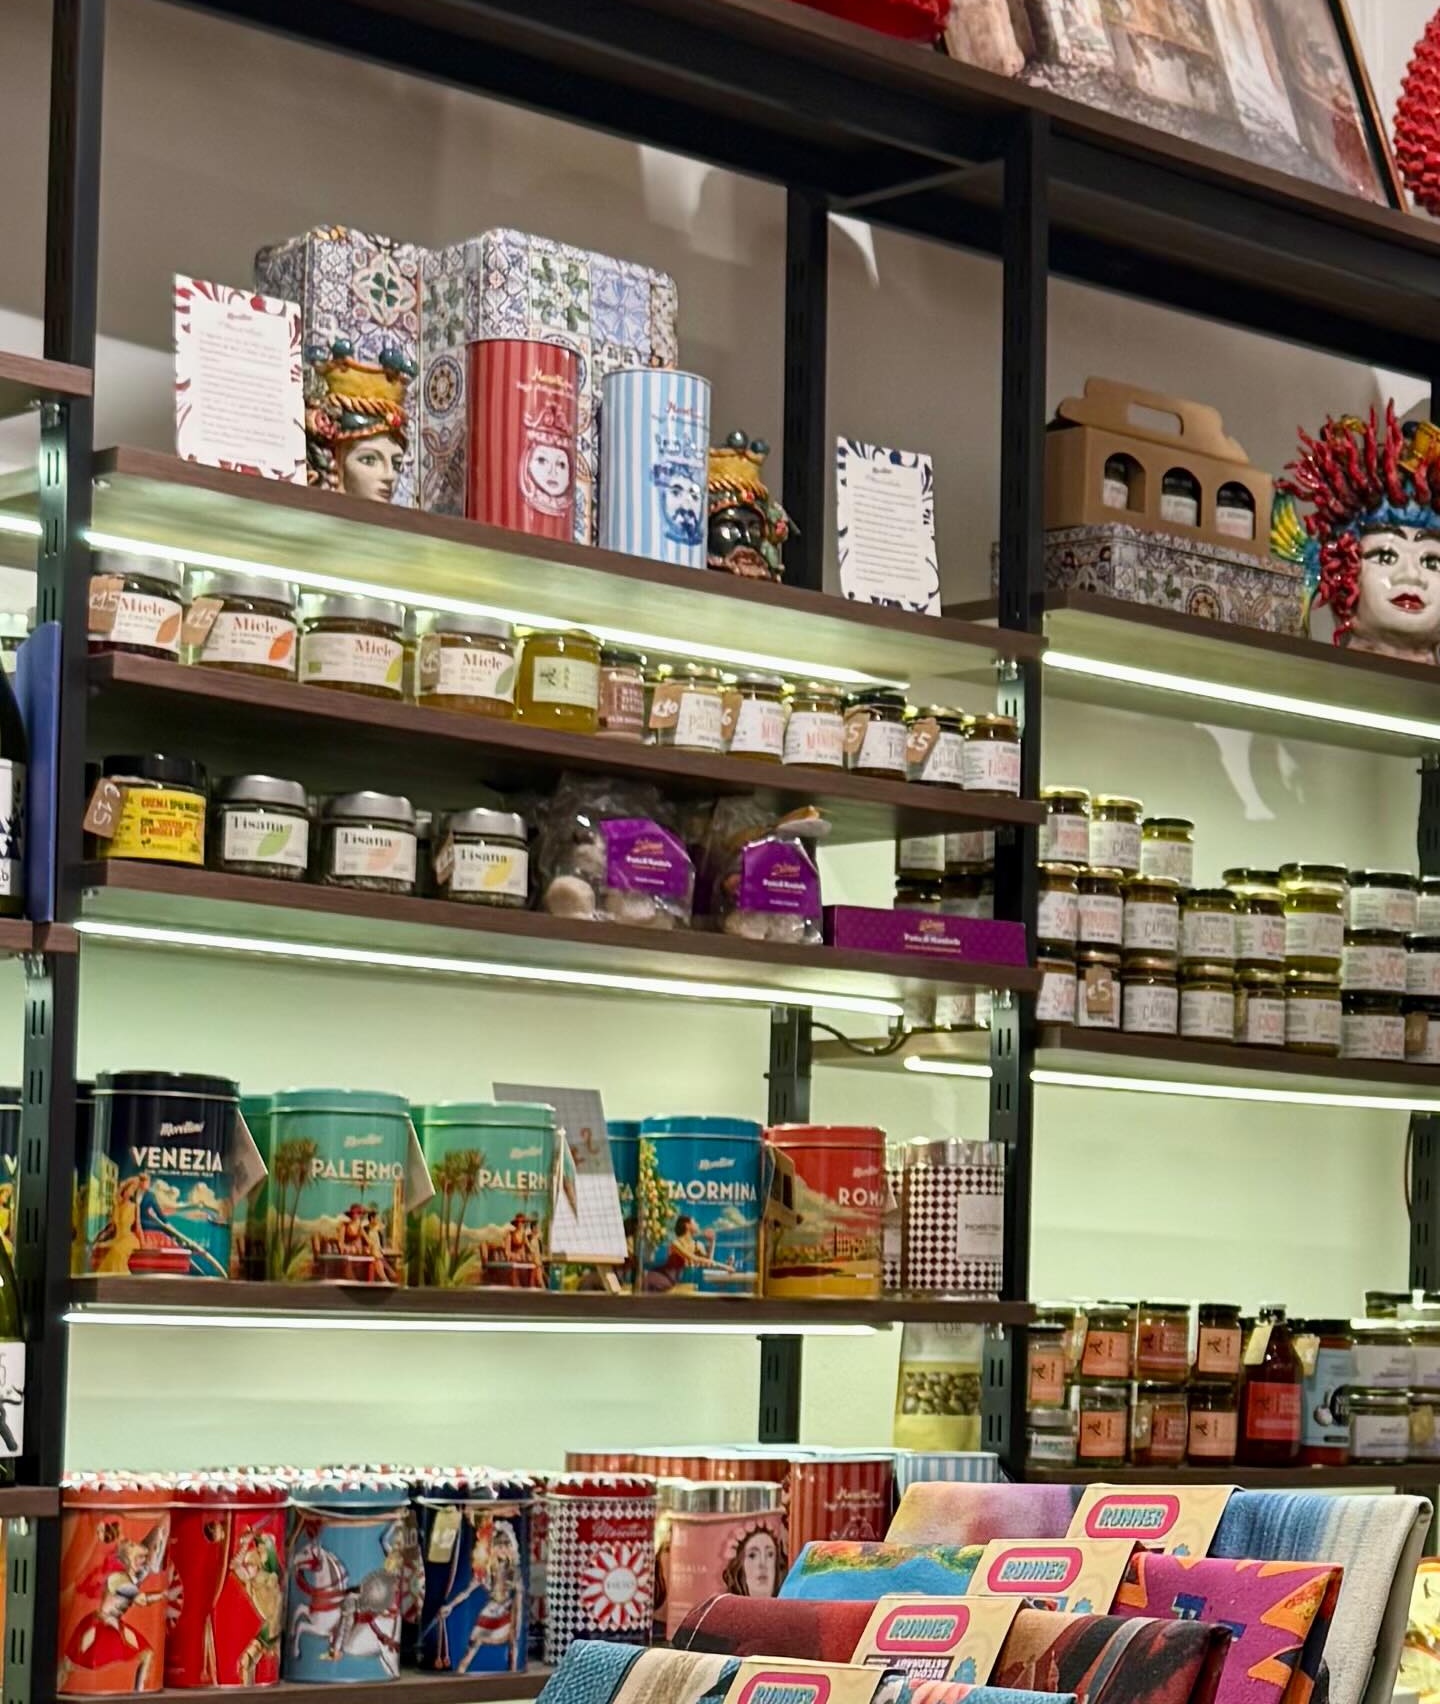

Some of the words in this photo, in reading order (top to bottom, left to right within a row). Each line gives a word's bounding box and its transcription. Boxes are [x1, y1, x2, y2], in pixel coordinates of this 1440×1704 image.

[119, 597, 166, 618] Miele
[232, 615, 279, 635] Miele
[353, 638, 394, 658] Miele
[462, 651, 503, 671] Miele
[230, 814, 284, 834] Tisana
[340, 830, 393, 848] Tisana
[458, 847, 508, 865] Tisana
[131, 1146, 223, 1173] VENEZIA
[311, 1157, 405, 1180] PALERMO
[478, 1167, 549, 1190] PALERM
[665, 1180, 758, 1202] TAORMINA
[1099, 1507, 1166, 1528] RUNNER
[999, 1561, 1068, 1582] RUNNER
[887, 1619, 957, 1640] RUNNER
